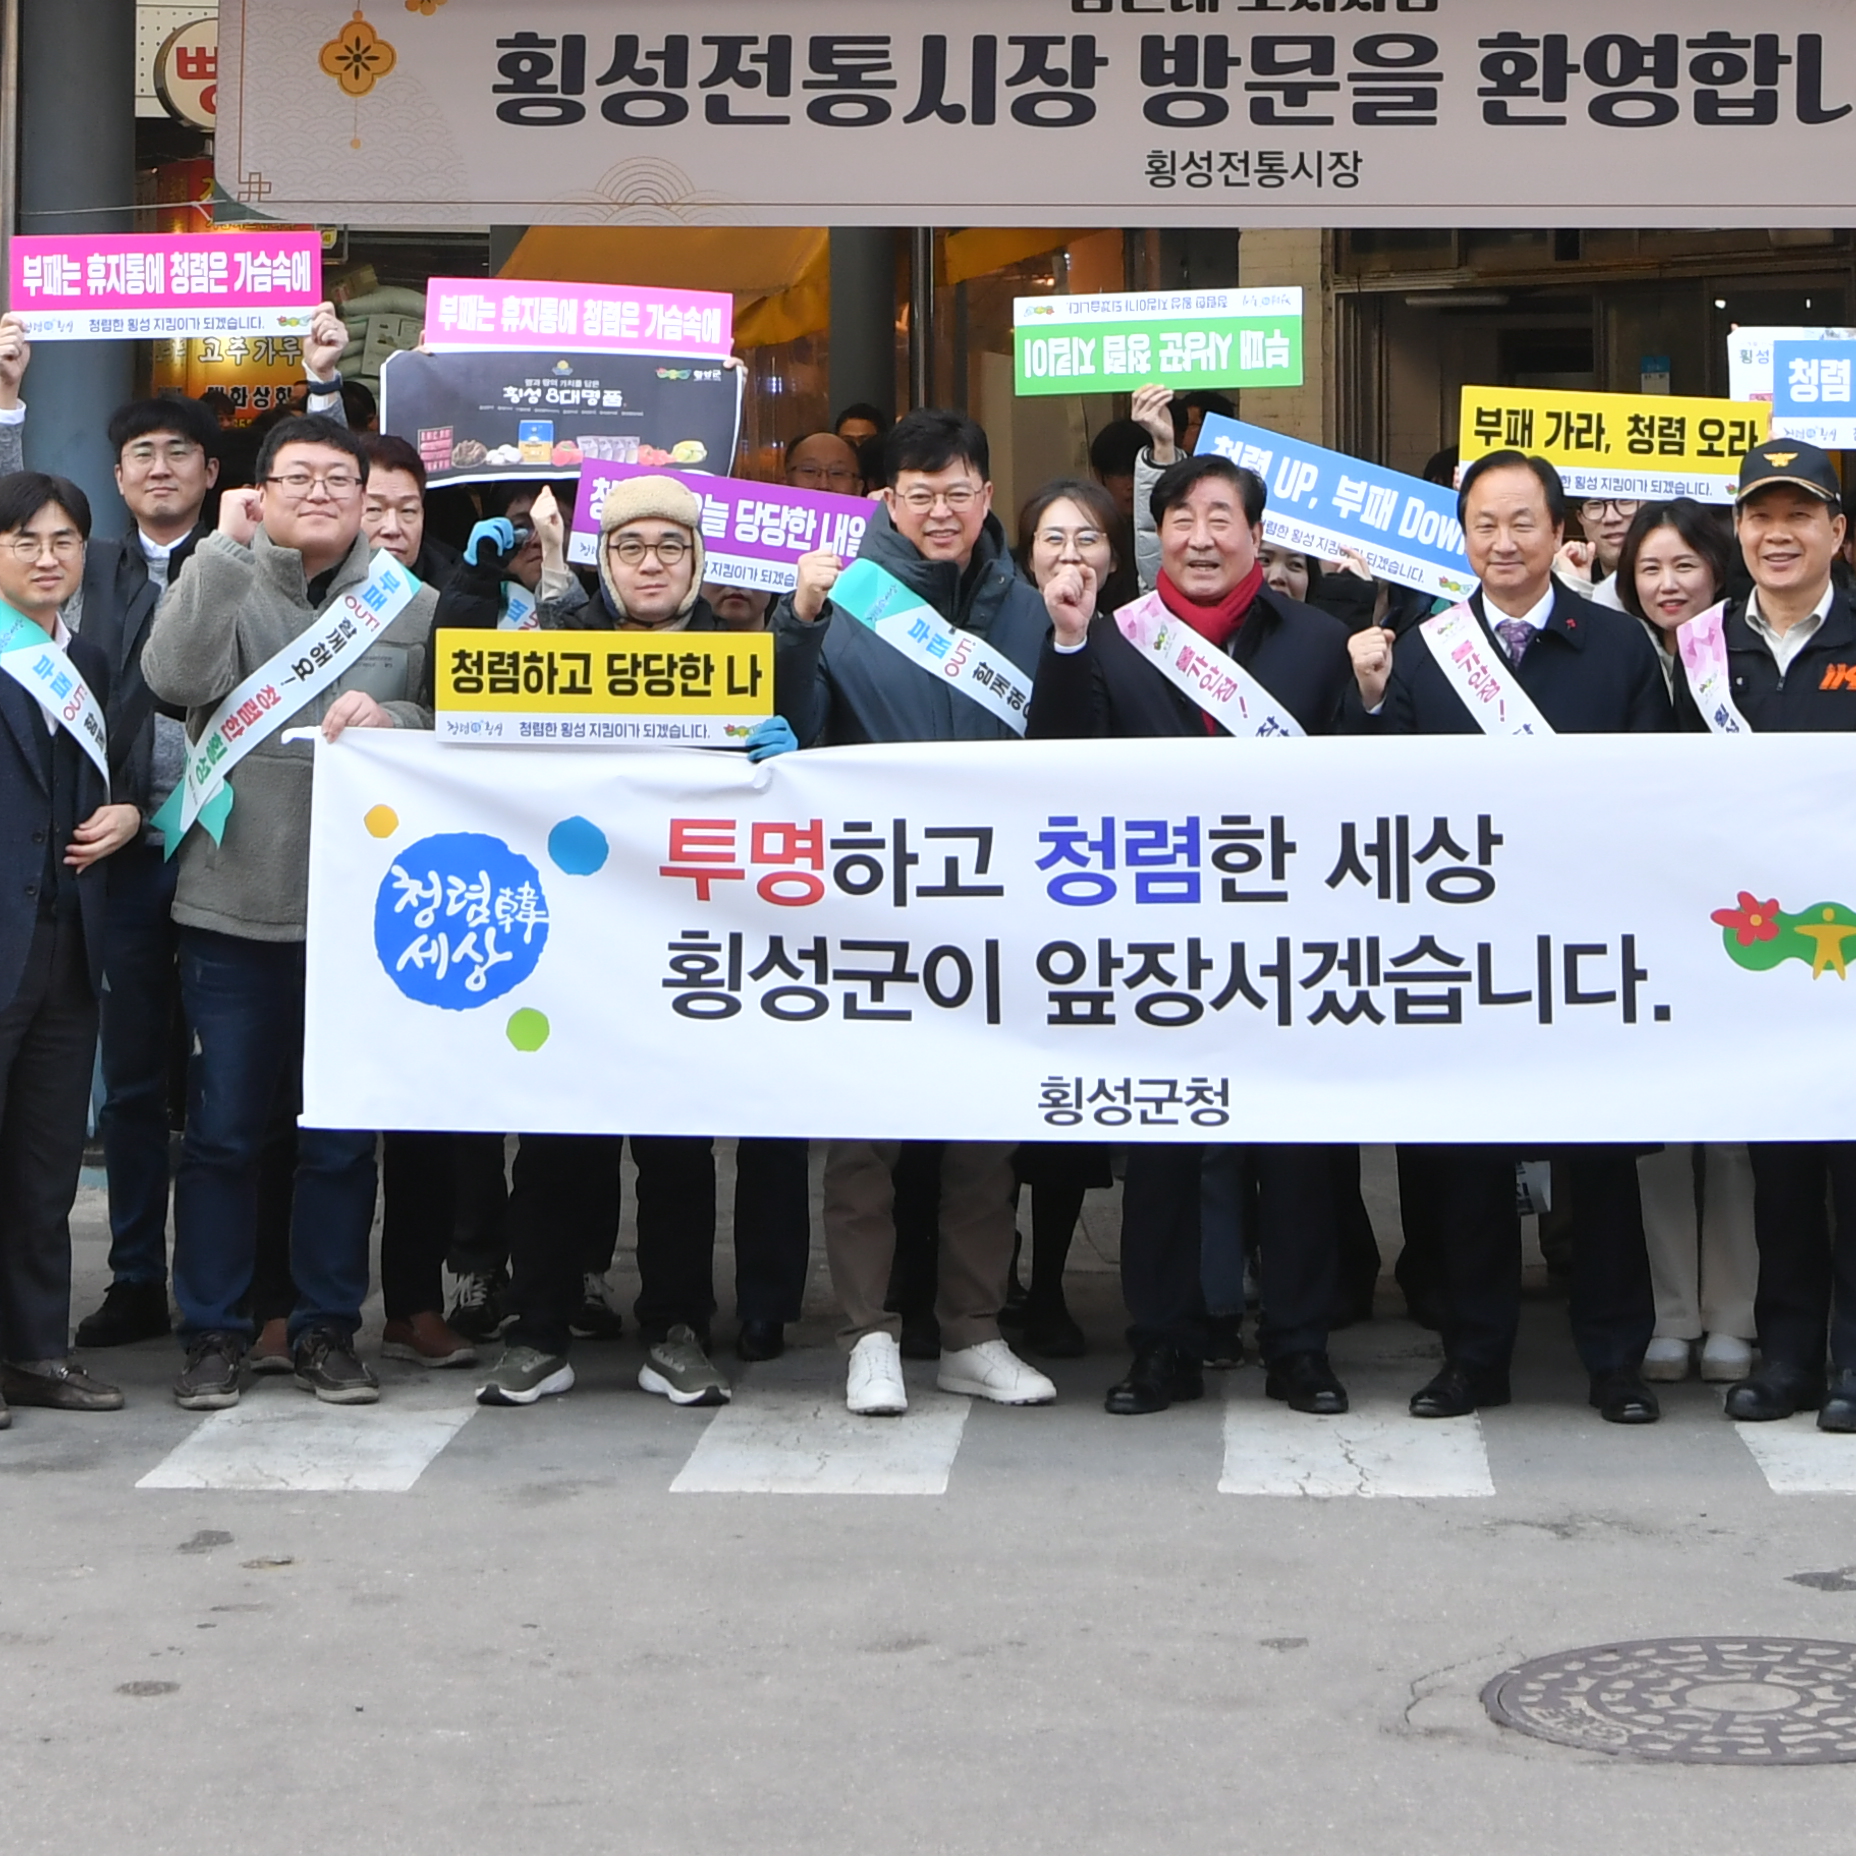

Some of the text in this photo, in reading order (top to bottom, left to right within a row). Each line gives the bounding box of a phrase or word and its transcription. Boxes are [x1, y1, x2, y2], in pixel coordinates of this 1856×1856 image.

[491, 30, 1109, 128] 횡성전통시장
[1139, 32, 1444, 129] 방문을
[1145, 149, 1363, 190] 횡성전통시장
[23, 250, 312, 297] 부패는 휴지통에 청렴은 가슴속에
[127, 318, 151, 333] 횡성
[154, 317, 201, 332] 지킴이가
[203, 316, 265, 331] 되겠습니다.
[438, 294, 722, 344] 부패는 휴지통에 청렴은 가슴속에
[1024, 336, 1096, 379] 지킴이
[1103, 332, 1152, 375] 청렴
[1240, 328, 1291, 370] 부패
[1788, 358, 1851, 403] 청렴
[1474, 406, 1758, 458] 부패 가라, 청렴 오라
[1273, 456, 1320, 510] UP,
[1331, 474, 1399, 532] 부패
[1574, 475, 1598, 491] 횡성
[1600, 477, 1648, 494] 지킴이가
[1650, 479, 1713, 497] 되겠습니다.
[734, 498, 867, 558] 당당한 내일
[1261, 520, 1290, 540] 렴한
[343, 593, 382, 634] OUT!
[450, 648, 762, 698] 청렴하고 당당한 나
[560, 721, 586, 738] 횡성
[589, 721, 641, 739] 지킴이가
[643, 722, 711, 739] 되겠습니다.
[659, 813, 1504, 908] 투명하고 청렴한 세상
[395, 926, 514, 992] 세상
[661, 929, 1672, 1028] 횡성군이 앞장서겠습니다.
[1038, 1075, 1230, 1127] 횡성군청
